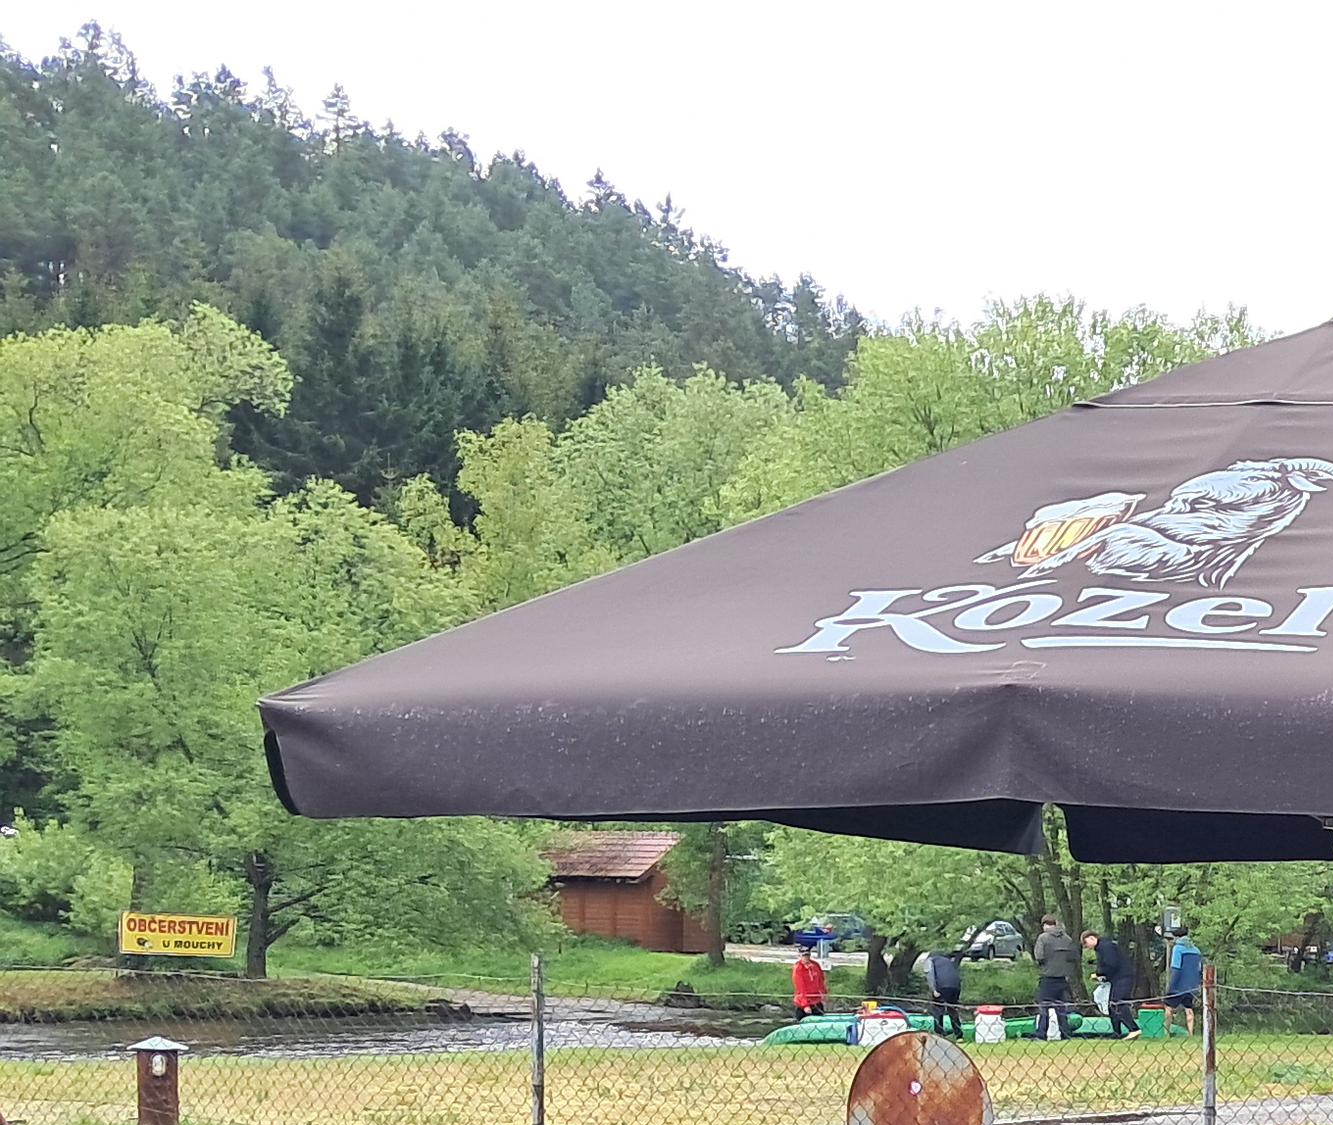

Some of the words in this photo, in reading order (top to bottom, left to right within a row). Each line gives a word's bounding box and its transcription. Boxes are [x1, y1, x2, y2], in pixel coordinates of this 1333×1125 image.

[126, 917, 230, 937] OBČERSTVENÍ
[162, 940, 171, 949] U
[174, 940, 224, 950] MOUCHY
